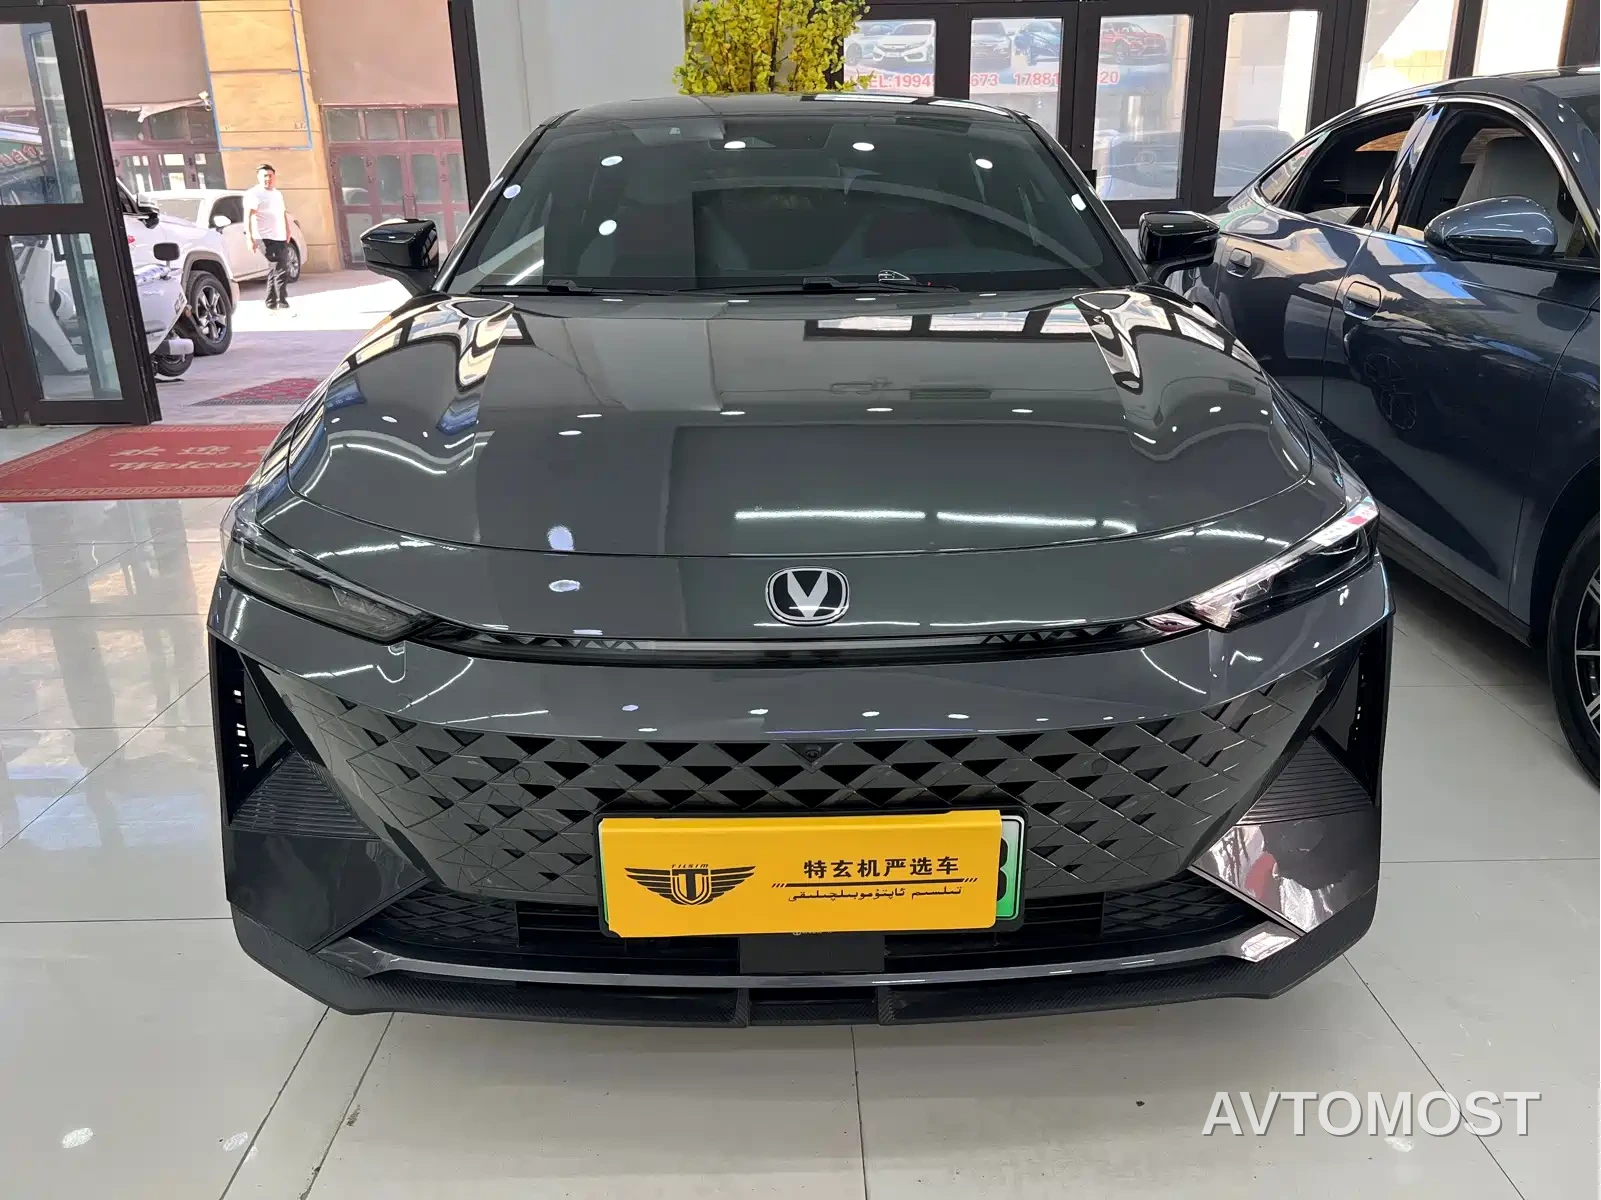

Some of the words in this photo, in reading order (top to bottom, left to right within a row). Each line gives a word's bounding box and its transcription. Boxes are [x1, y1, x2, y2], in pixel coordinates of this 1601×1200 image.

[803, 856, 959, 879] 特玄机严选车
